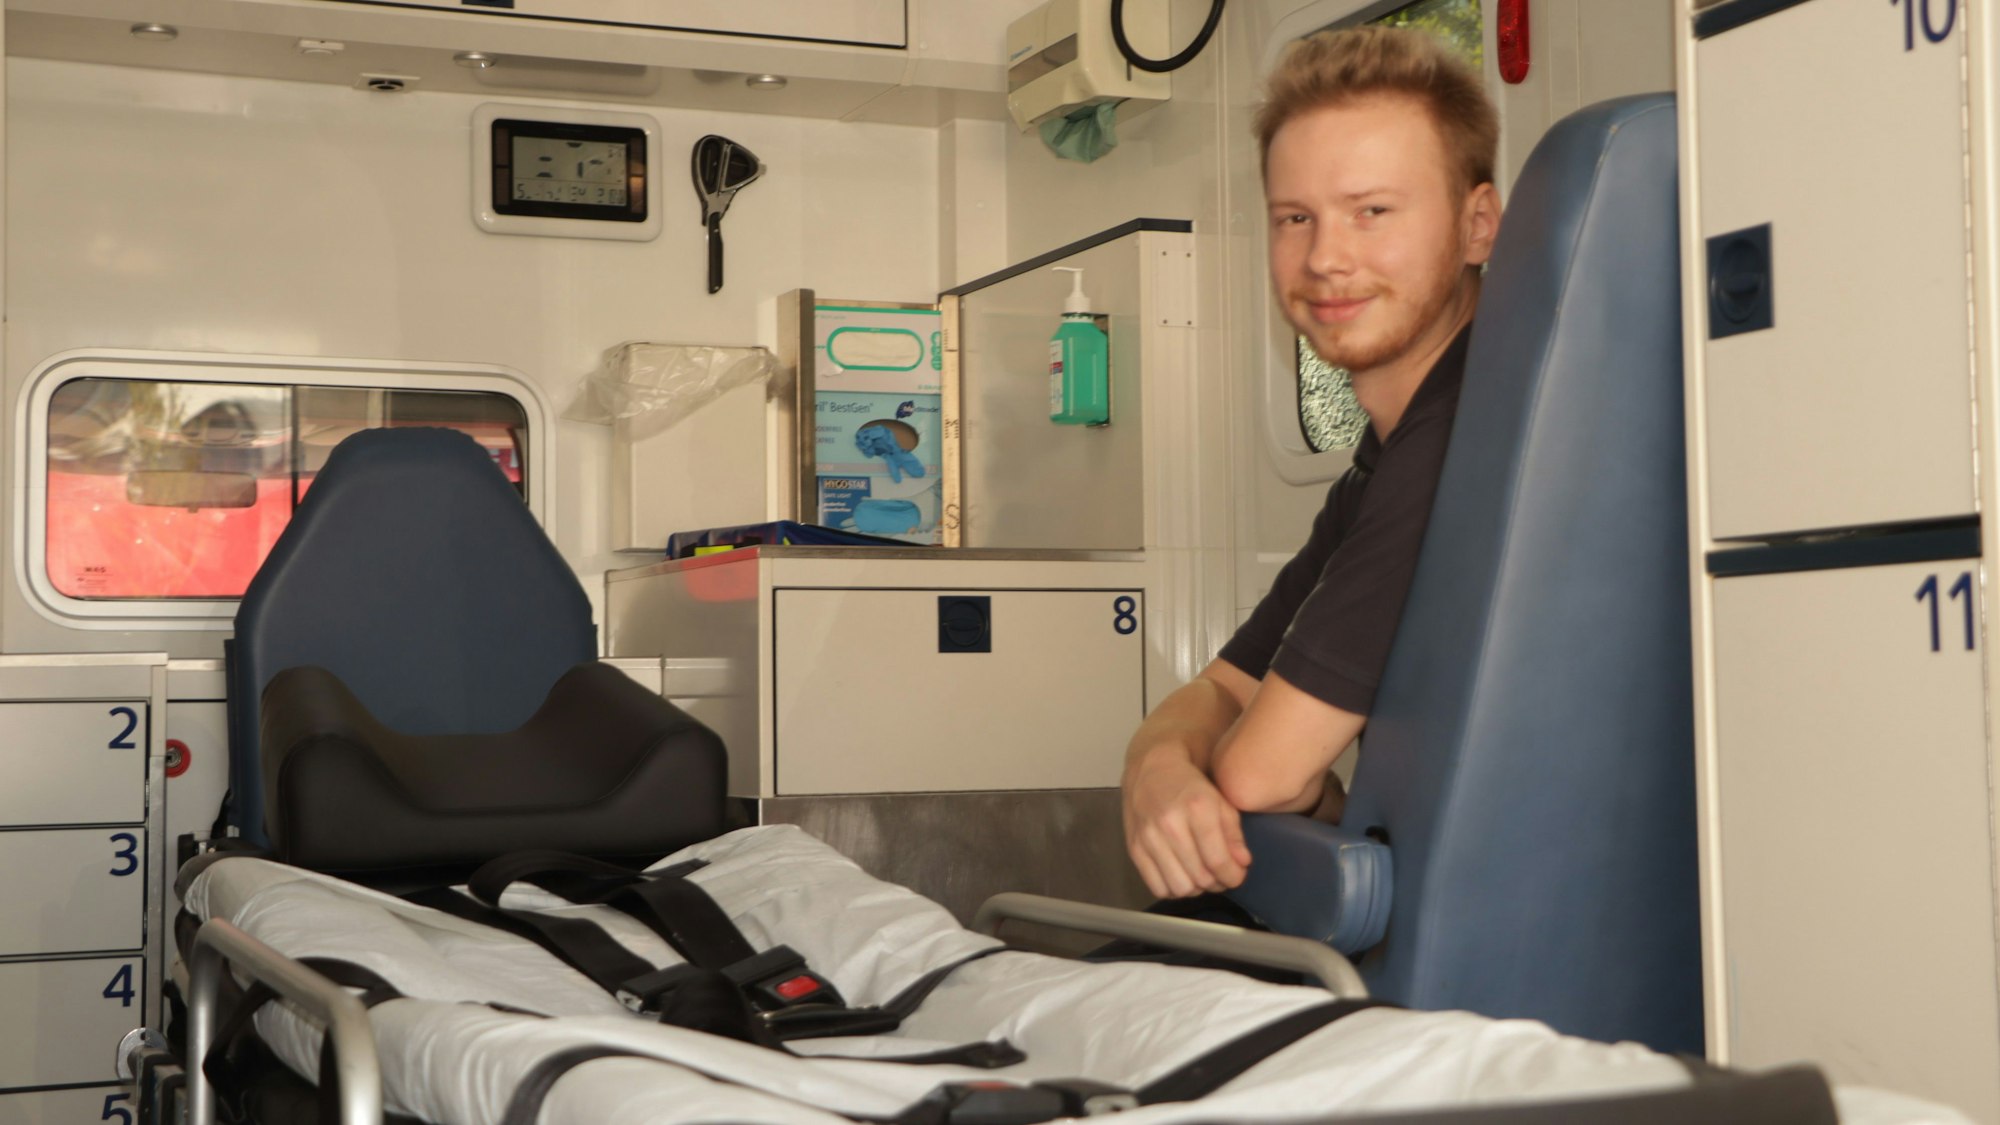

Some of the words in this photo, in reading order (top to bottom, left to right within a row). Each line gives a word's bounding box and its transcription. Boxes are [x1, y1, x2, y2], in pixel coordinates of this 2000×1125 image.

[1891, 0, 1957, 52] 10
[823, 479, 867, 489] HYGOSTAR
[1113, 595, 1137, 635] 8
[1914, 572, 1975, 652] 11
[108, 706, 138, 749] 2
[108, 832, 139, 877] 3
[102, 964, 136, 1008] 4
[101, 1092, 133, 1125] 5
